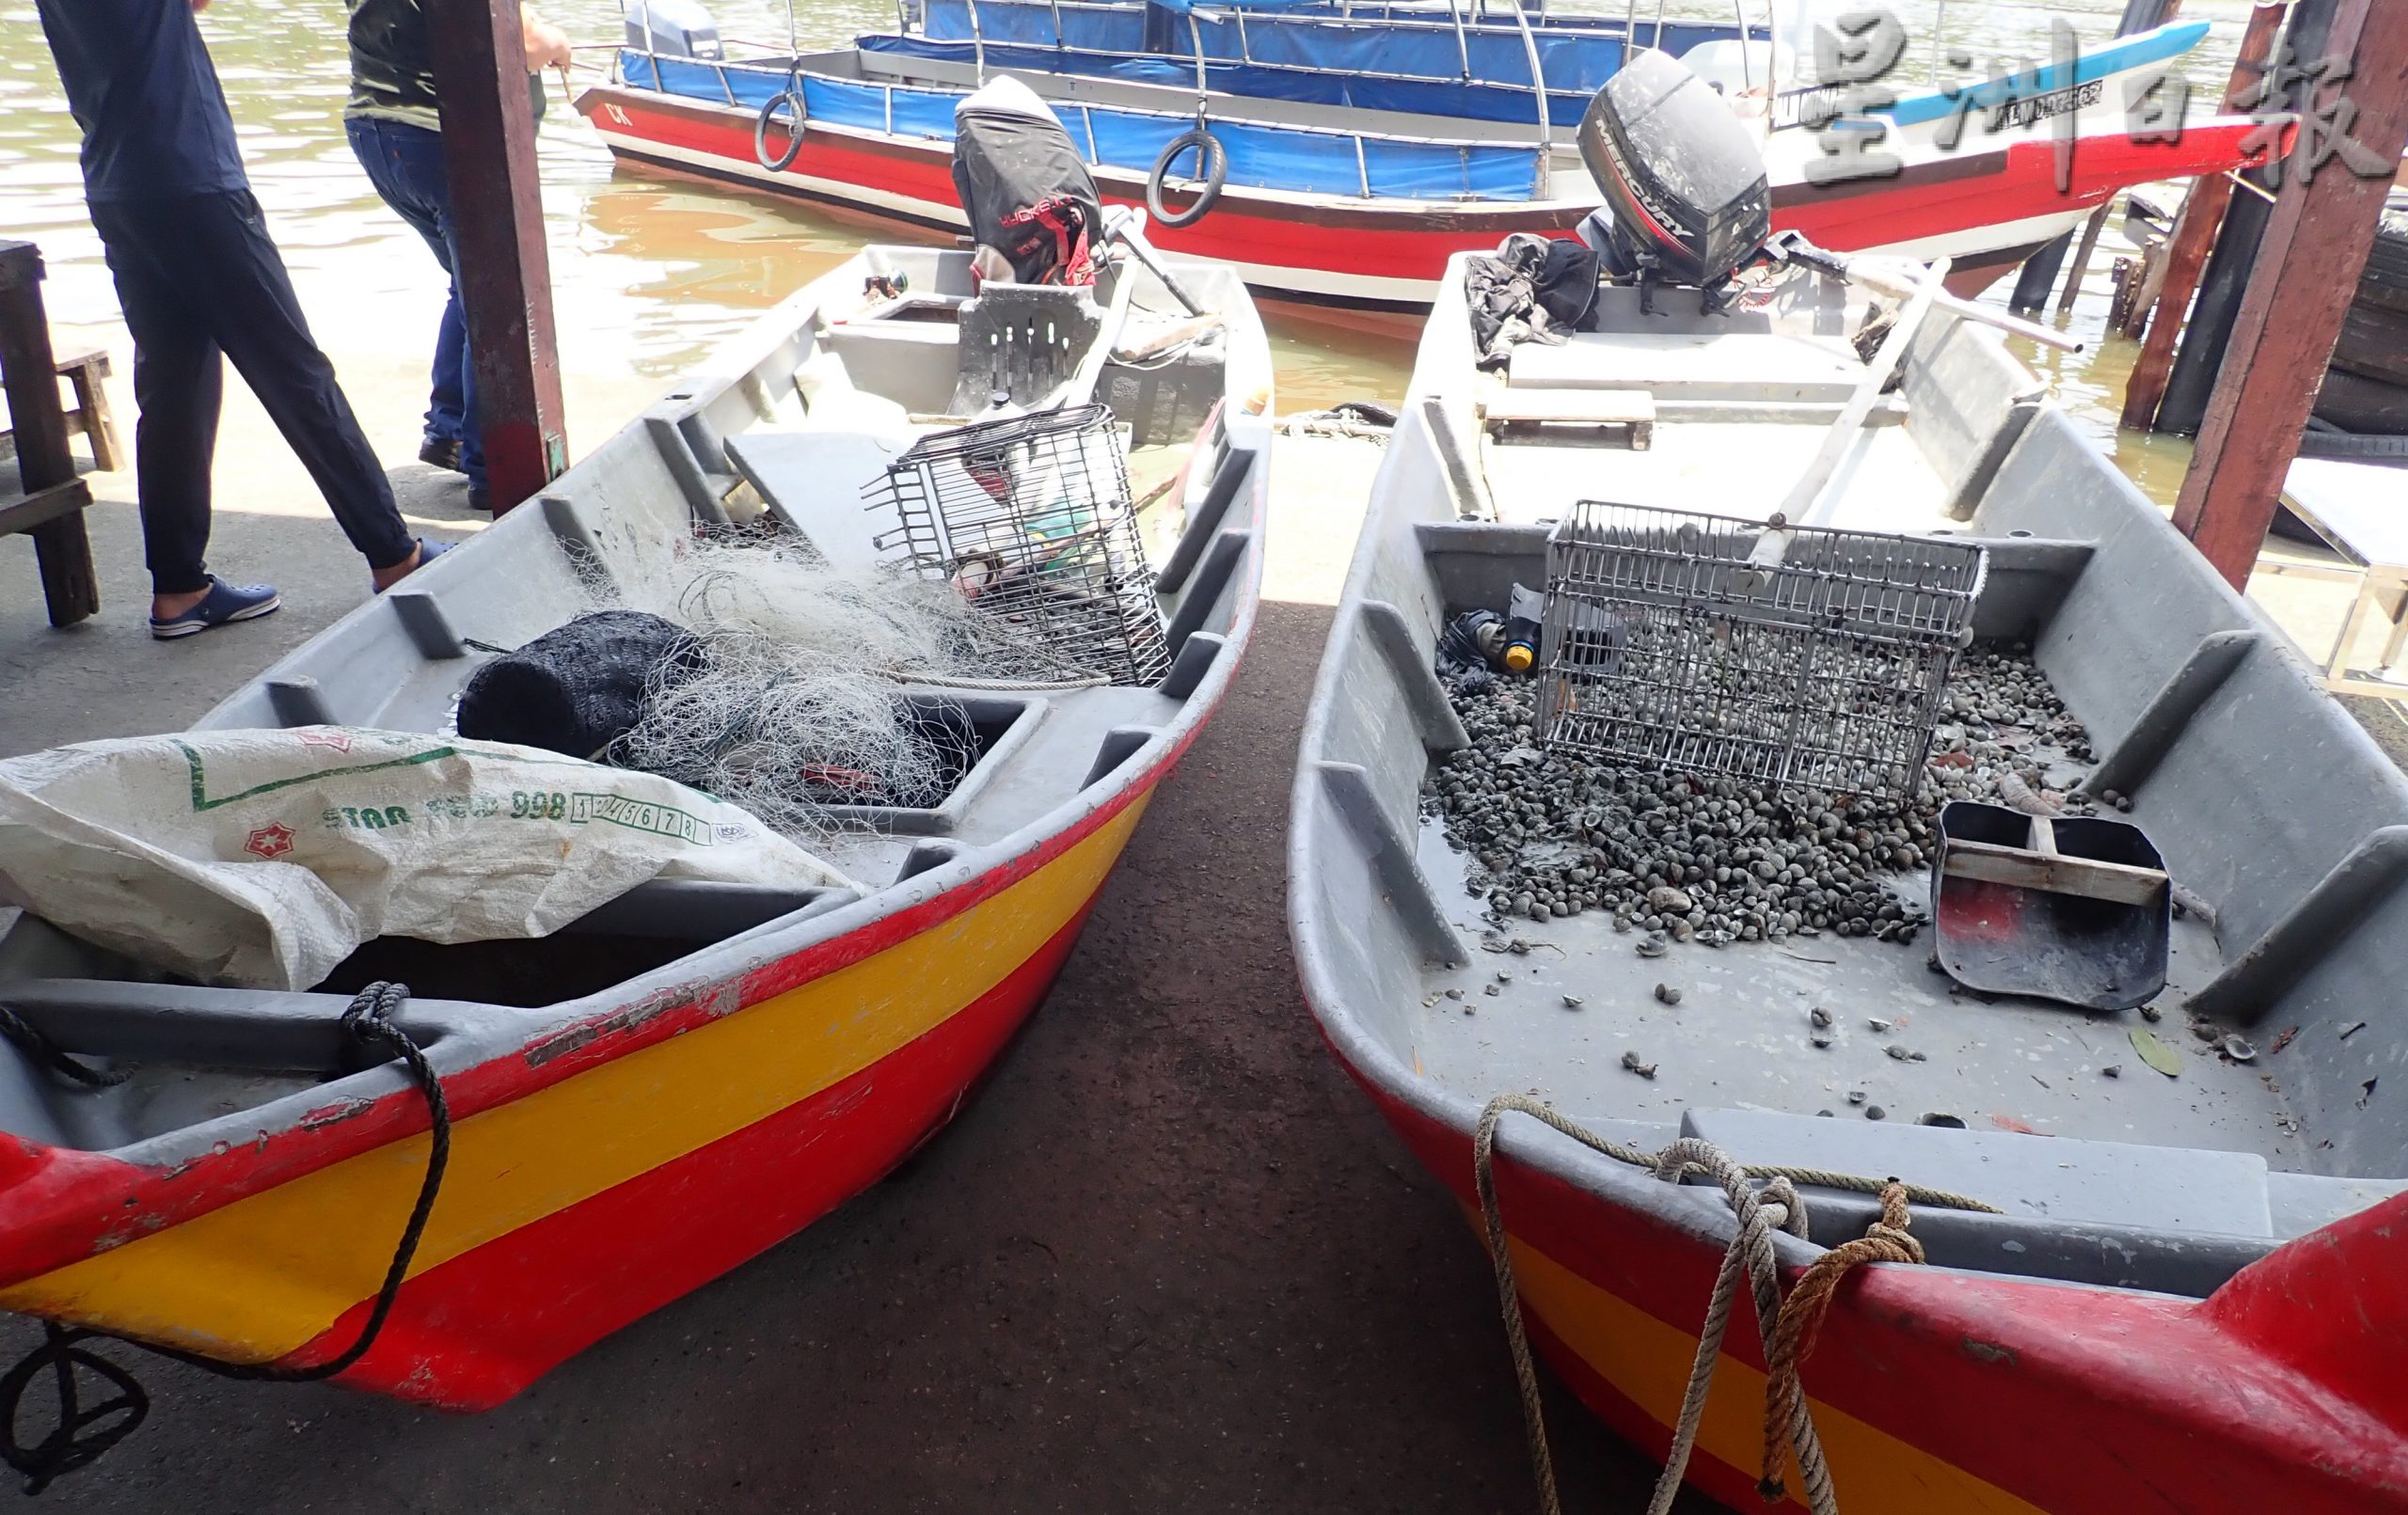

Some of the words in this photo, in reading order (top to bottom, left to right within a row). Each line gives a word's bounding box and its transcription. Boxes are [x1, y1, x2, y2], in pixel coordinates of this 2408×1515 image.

[604, 103, 633, 126] CK
[1594, 118, 1695, 237] MERCURY
[509, 789, 565, 821] 998
[625, 805, 637, 820] 5
[642, 808, 651, 826] 6
[666, 813, 675, 830] 7
